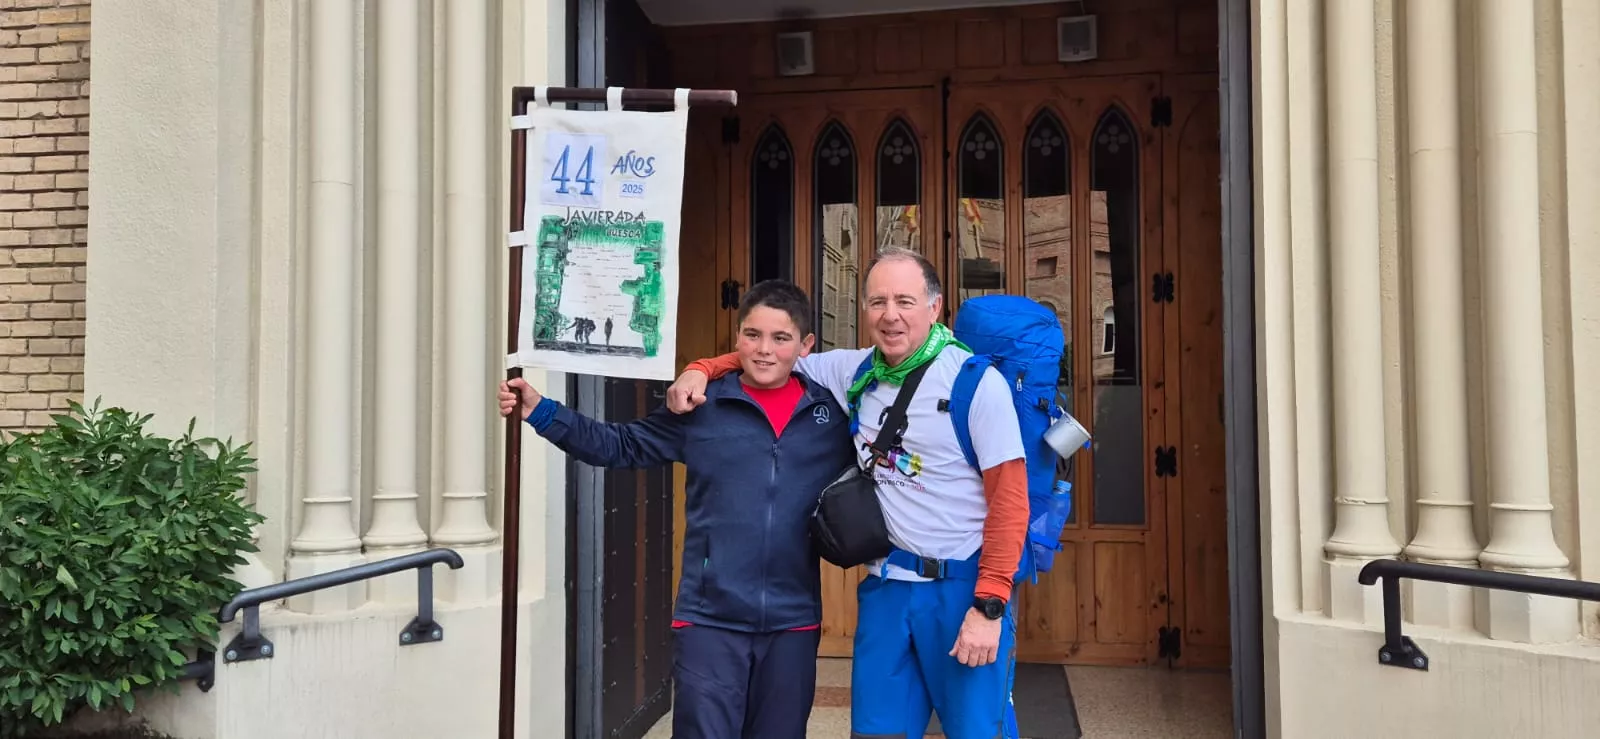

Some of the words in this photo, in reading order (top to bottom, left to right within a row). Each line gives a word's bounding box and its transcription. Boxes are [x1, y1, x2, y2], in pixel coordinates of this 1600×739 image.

[550, 144, 595, 196] 44
[610, 149, 656, 178] AÑOS
[622, 183, 643, 194] 2025
[563, 206, 647, 225] JAVIERADA
[606, 228, 642, 238] HUESCA
